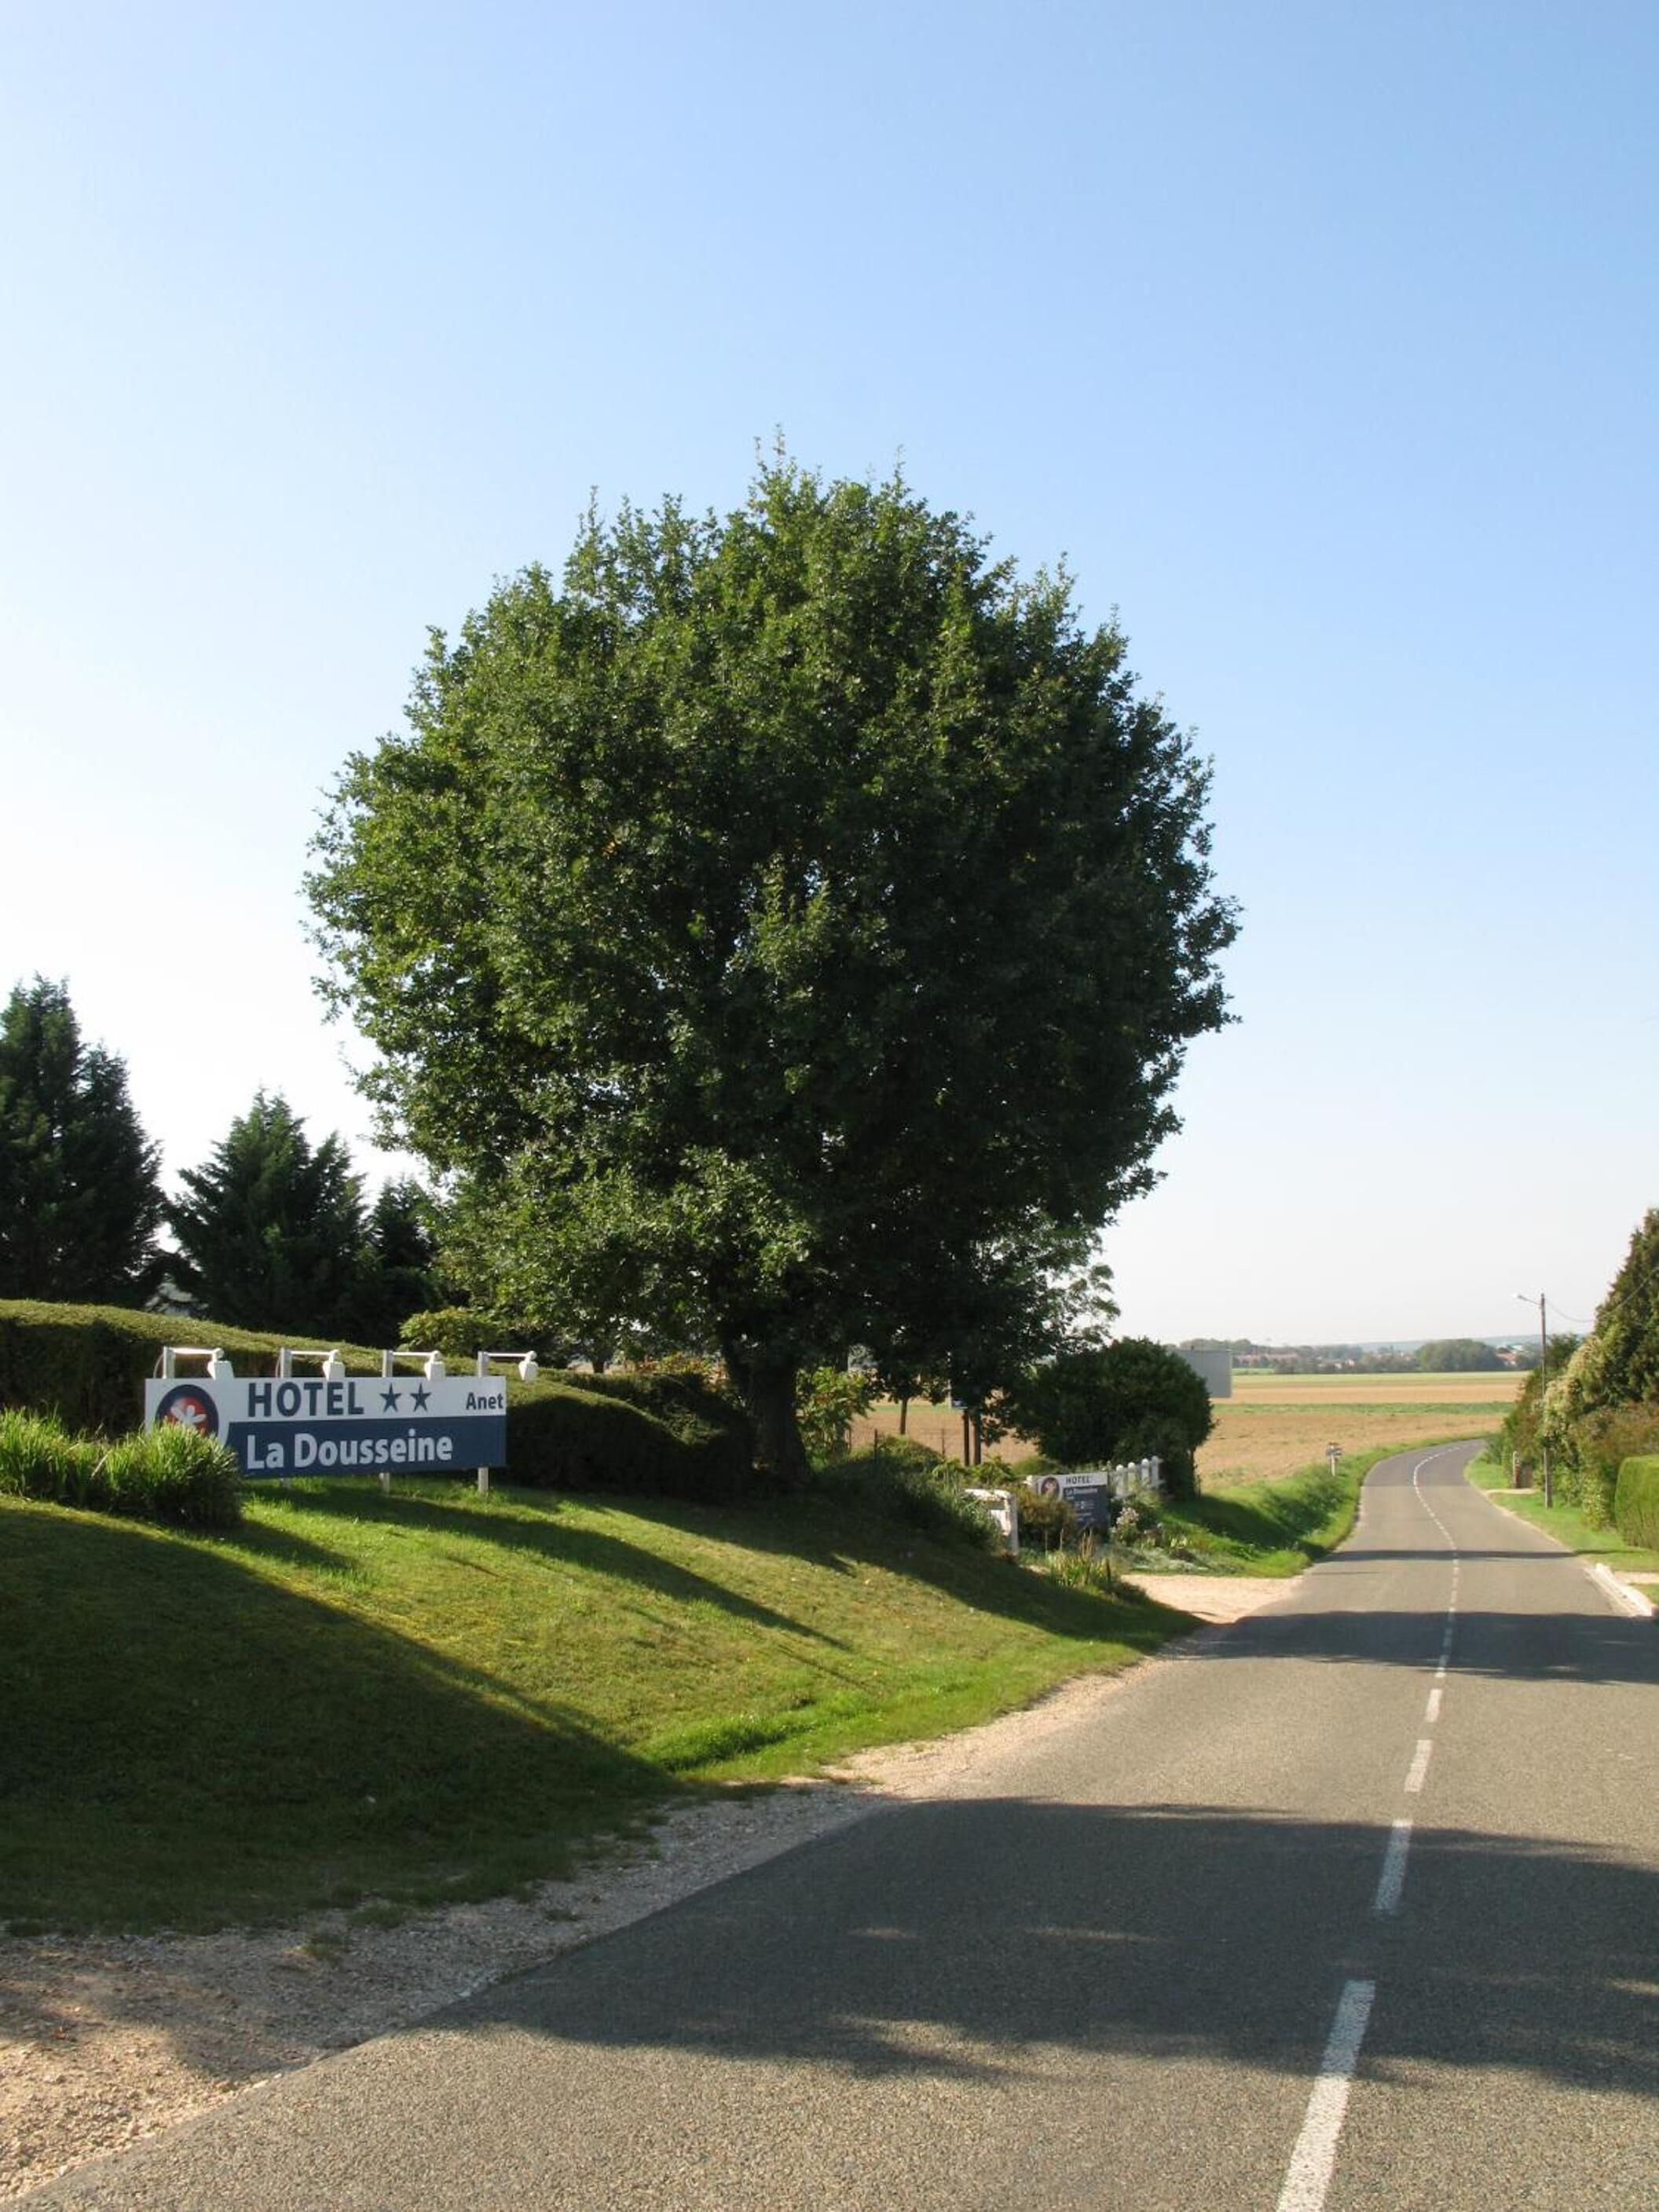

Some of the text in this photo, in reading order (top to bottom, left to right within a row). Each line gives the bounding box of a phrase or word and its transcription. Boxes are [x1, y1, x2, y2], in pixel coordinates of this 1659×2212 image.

[248, 1382, 504, 1417] HOTEL Anet
[247, 1428, 452, 1470] La Dousseine
